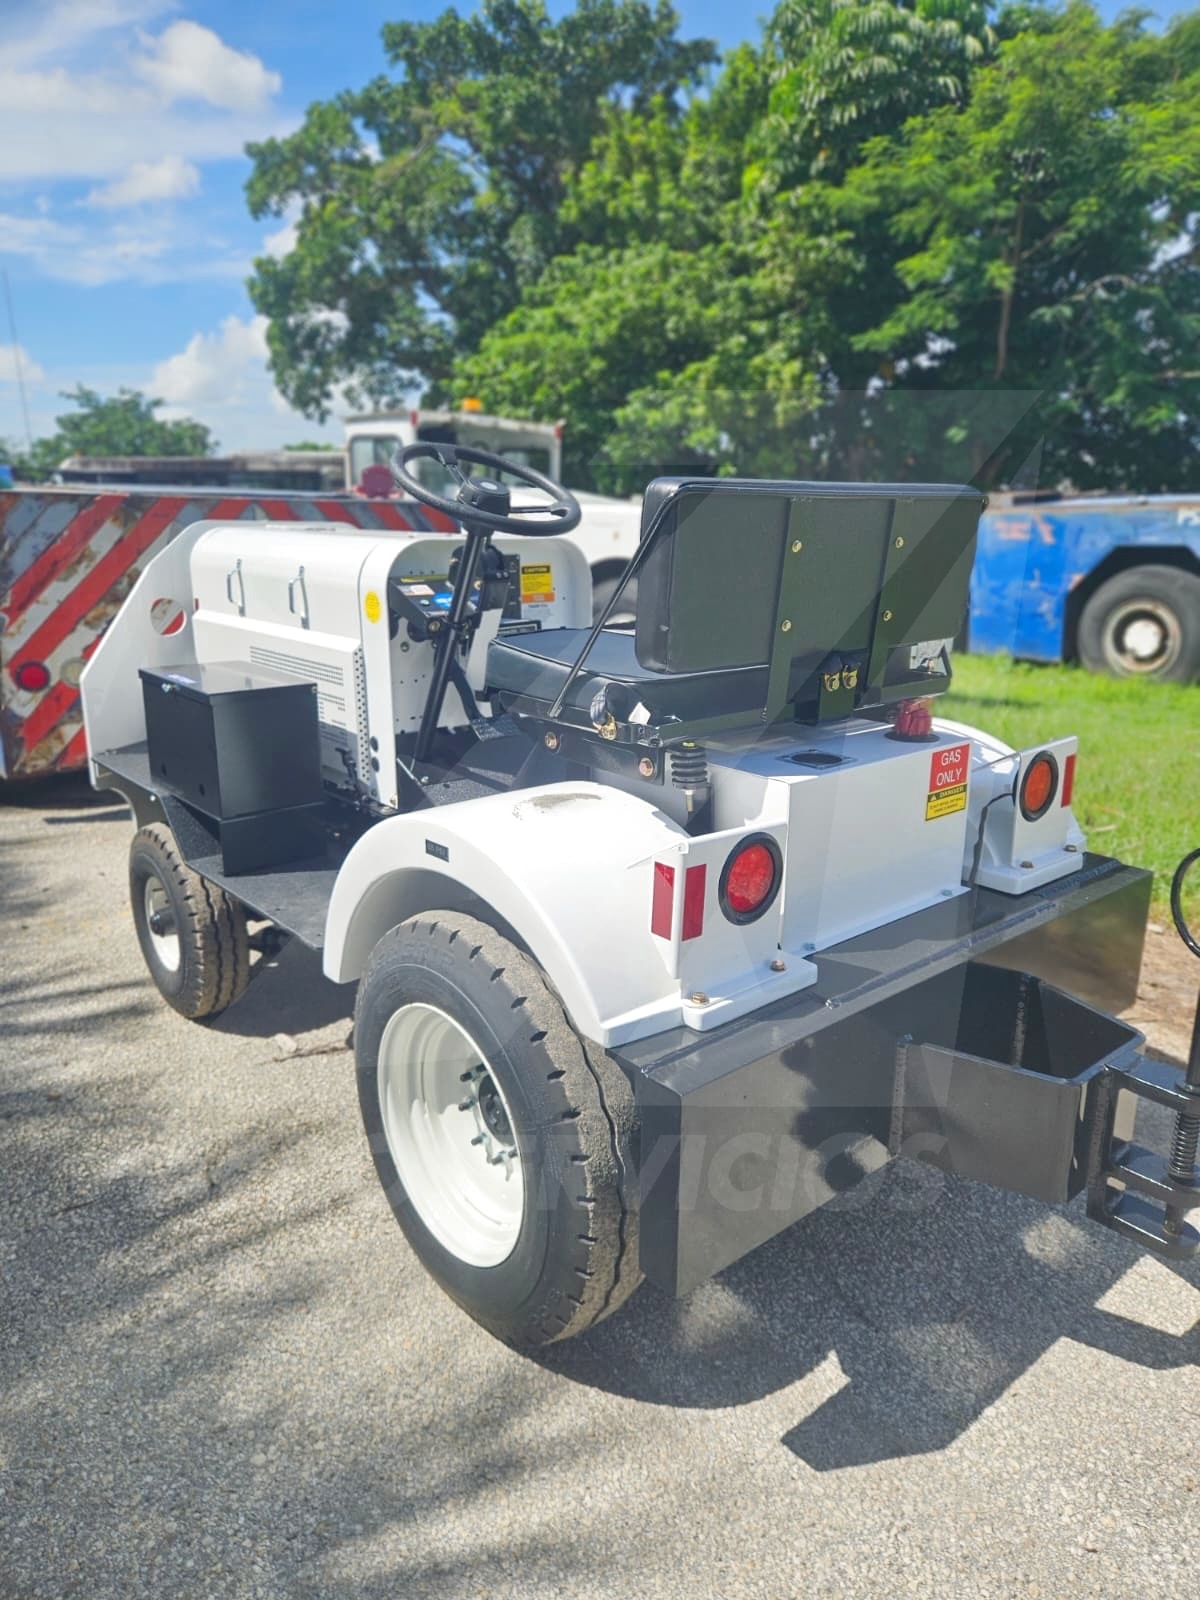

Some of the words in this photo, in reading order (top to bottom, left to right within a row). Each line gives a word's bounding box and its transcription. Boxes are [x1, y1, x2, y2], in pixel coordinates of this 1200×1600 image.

[941, 749, 961, 765] GAS
[936, 768, 963, 786] ONLY
[939, 786, 964, 798] DANGER
